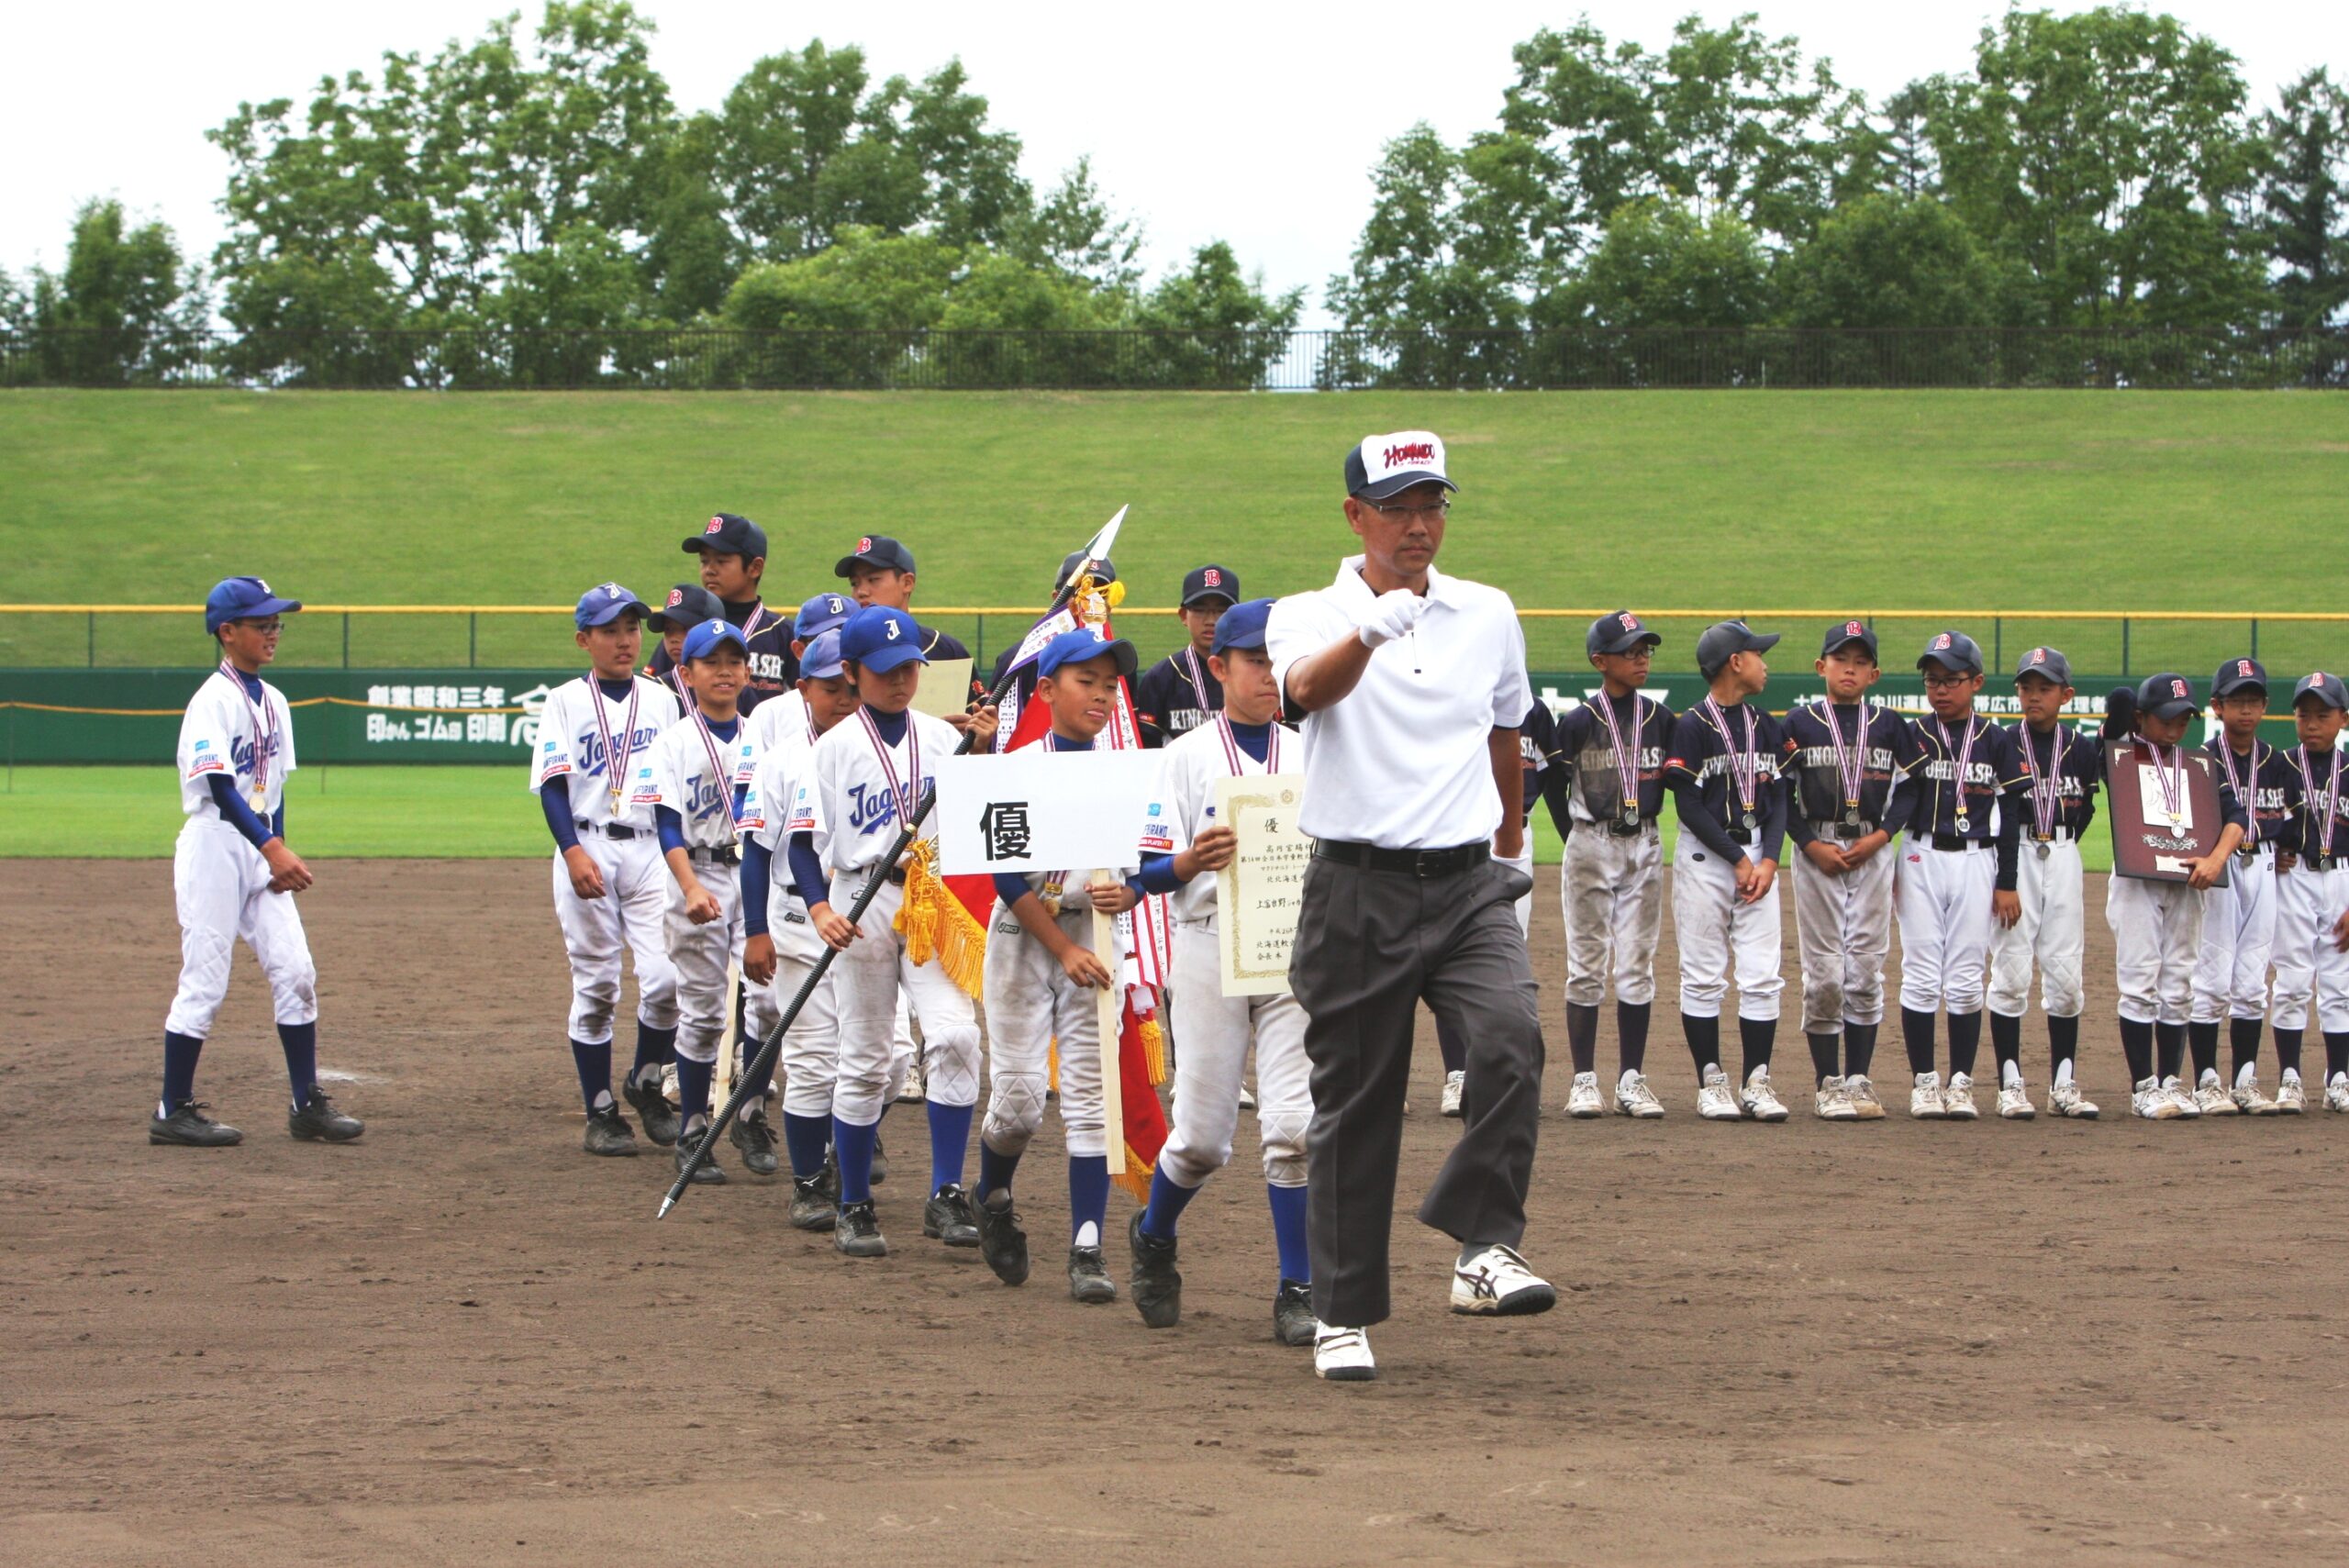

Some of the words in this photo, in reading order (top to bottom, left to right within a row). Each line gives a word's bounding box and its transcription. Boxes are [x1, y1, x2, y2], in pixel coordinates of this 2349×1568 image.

[705, 516, 723, 535] B
[854, 537, 872, 556] B
[1205, 569, 1221, 587] B
[666, 588, 683, 608] B
[884, 618, 901, 641] J
[1619, 611, 1639, 632] B
[1845, 619, 1863, 637] B
[1934, 633, 1952, 651] B
[2031, 647, 2046, 665] B
[2237, 660, 2254, 678] B
[2170, 679, 2188, 698] B
[2309, 671, 2325, 688] B
[467, 714, 507, 741] 印刷
[979, 802, 1031, 861] 優
[1264, 817, 1279, 833] 優
